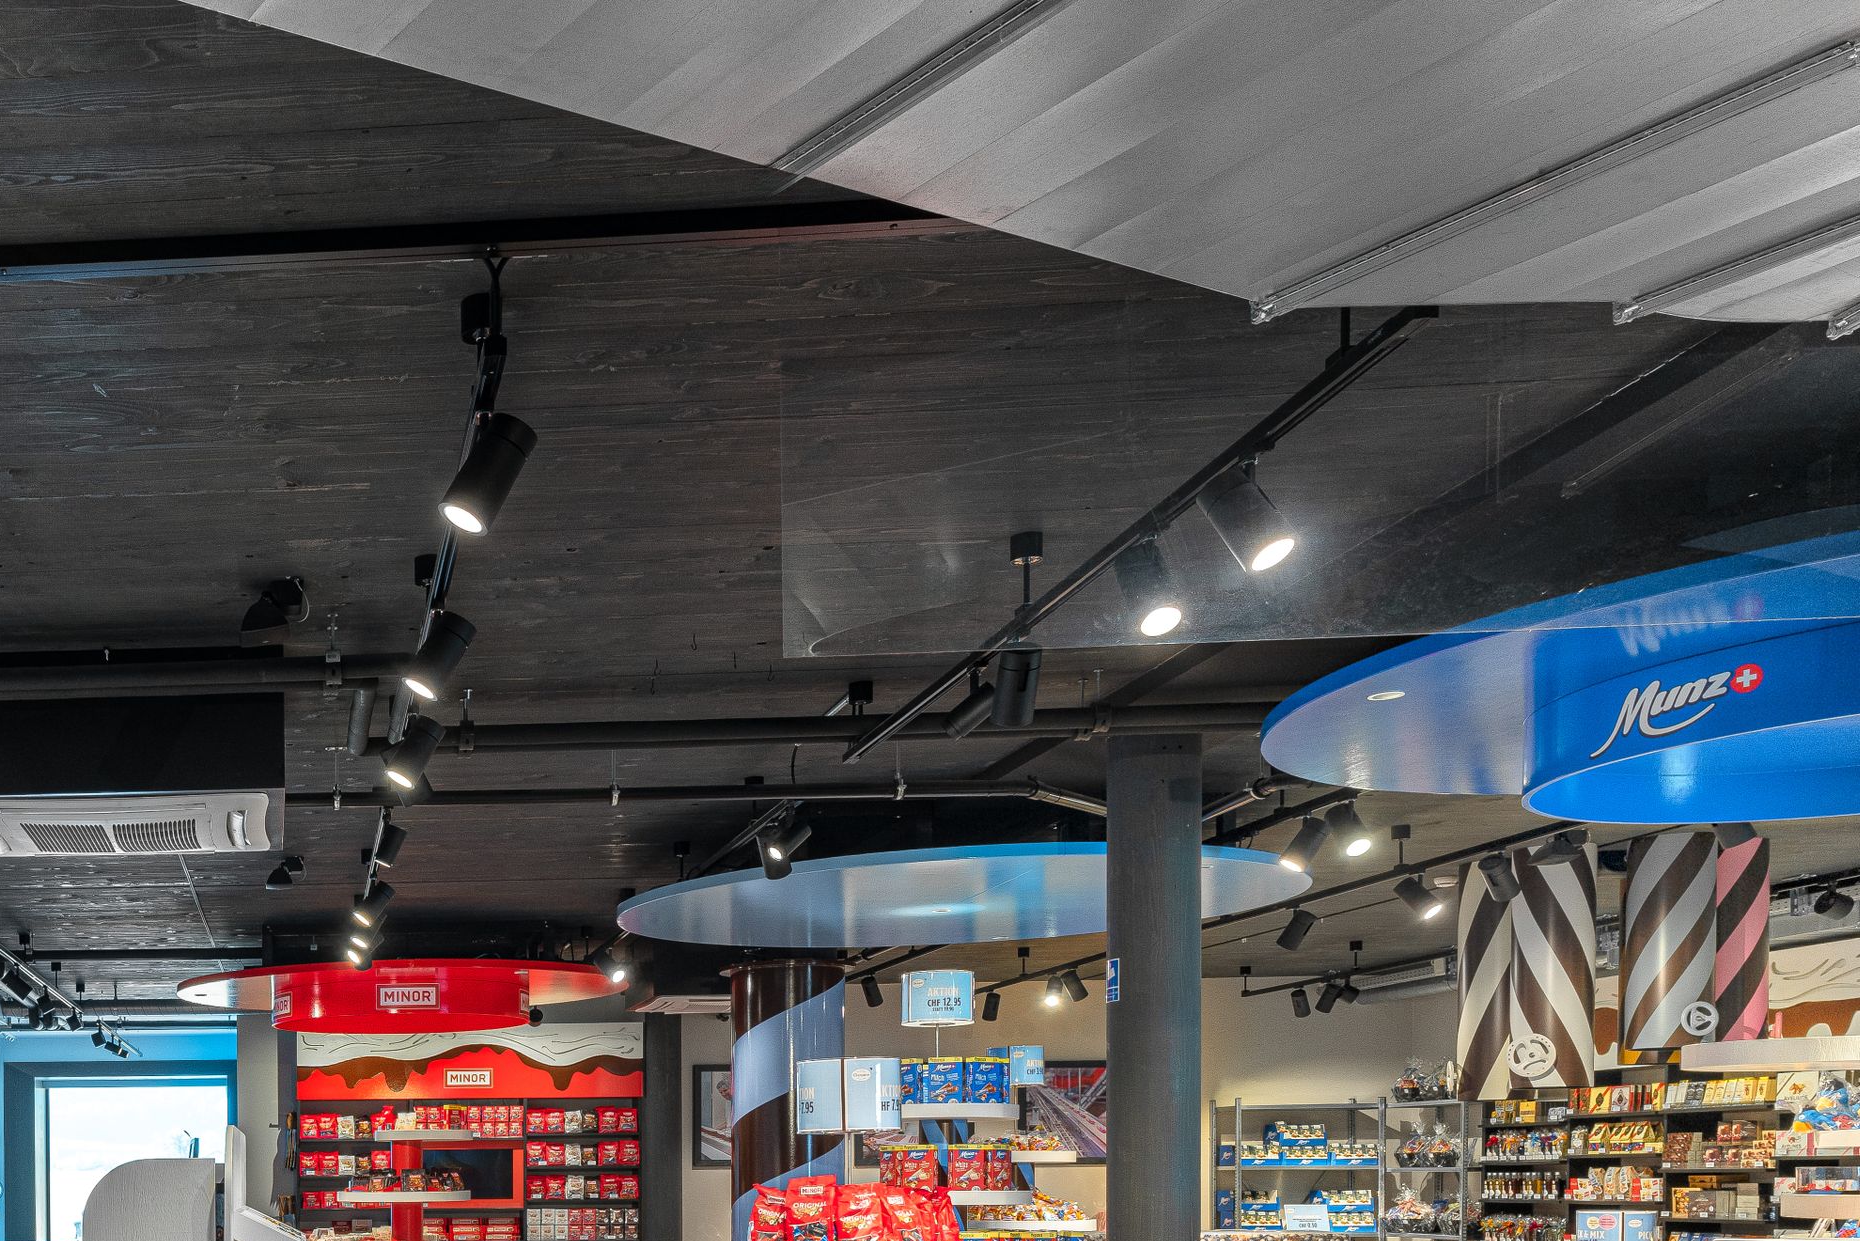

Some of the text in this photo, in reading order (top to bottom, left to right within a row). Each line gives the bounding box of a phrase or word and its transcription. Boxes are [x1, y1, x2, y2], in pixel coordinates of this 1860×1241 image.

[1589, 671, 1732, 758] Munz
[384, 990, 431, 1003] MINOR
[927, 997, 962, 1007] CHF 12.95
[450, 1073, 486, 1083] MINOR
[801, 1101, 814, 1114] 7.95
[801, 1187, 823, 1195] MINOR
[792, 1201, 827, 1209] ORIGINAL
[1590, 1230, 1605, 1239] MIX
